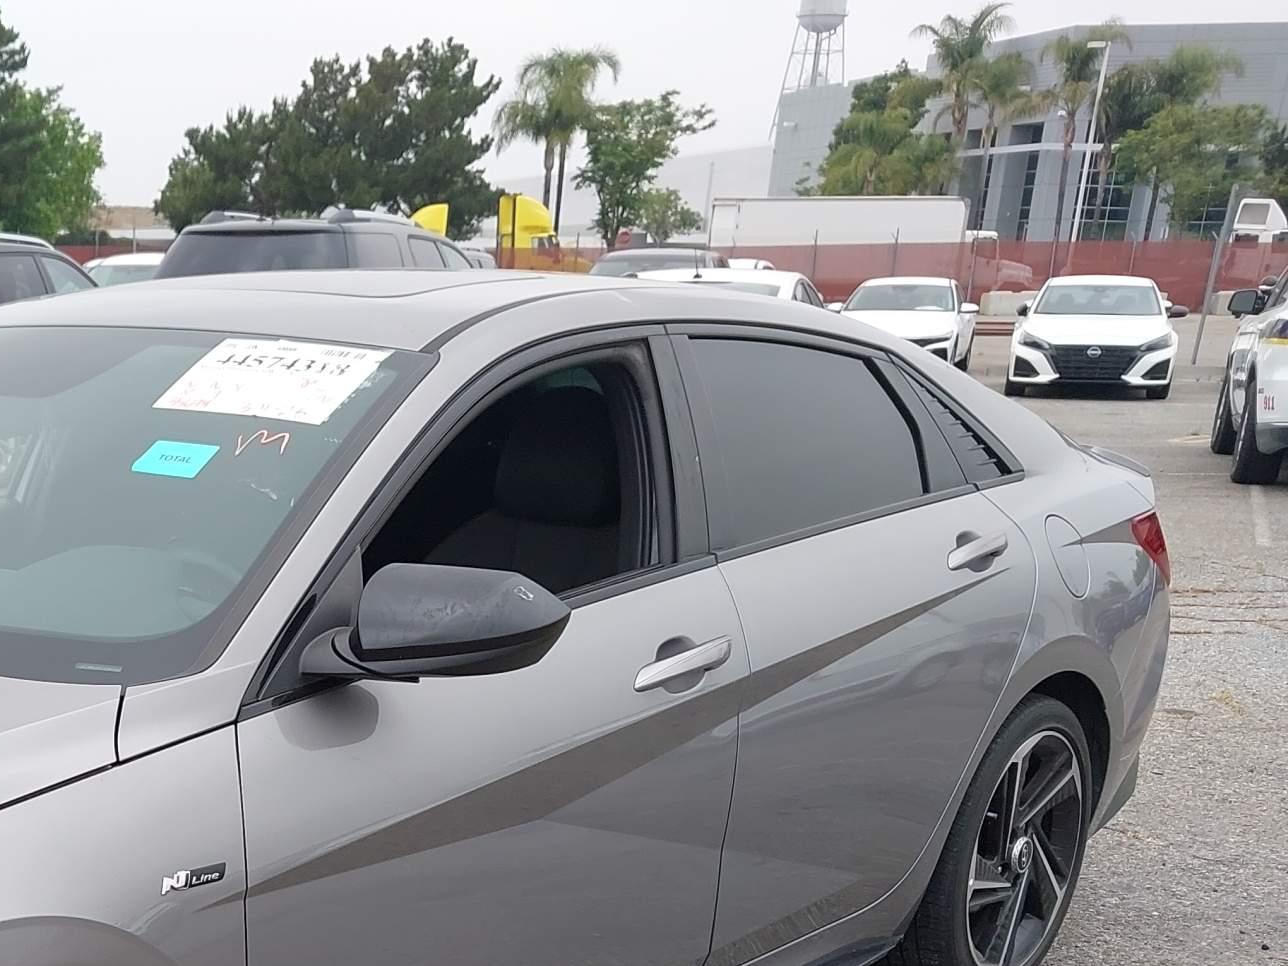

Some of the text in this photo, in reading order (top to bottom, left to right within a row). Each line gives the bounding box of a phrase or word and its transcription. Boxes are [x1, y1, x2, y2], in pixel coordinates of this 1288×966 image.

[1263, 395, 1275, 410] 911
[159, 453, 192, 464] TOTAL
[191, 872, 220, 885] Line
